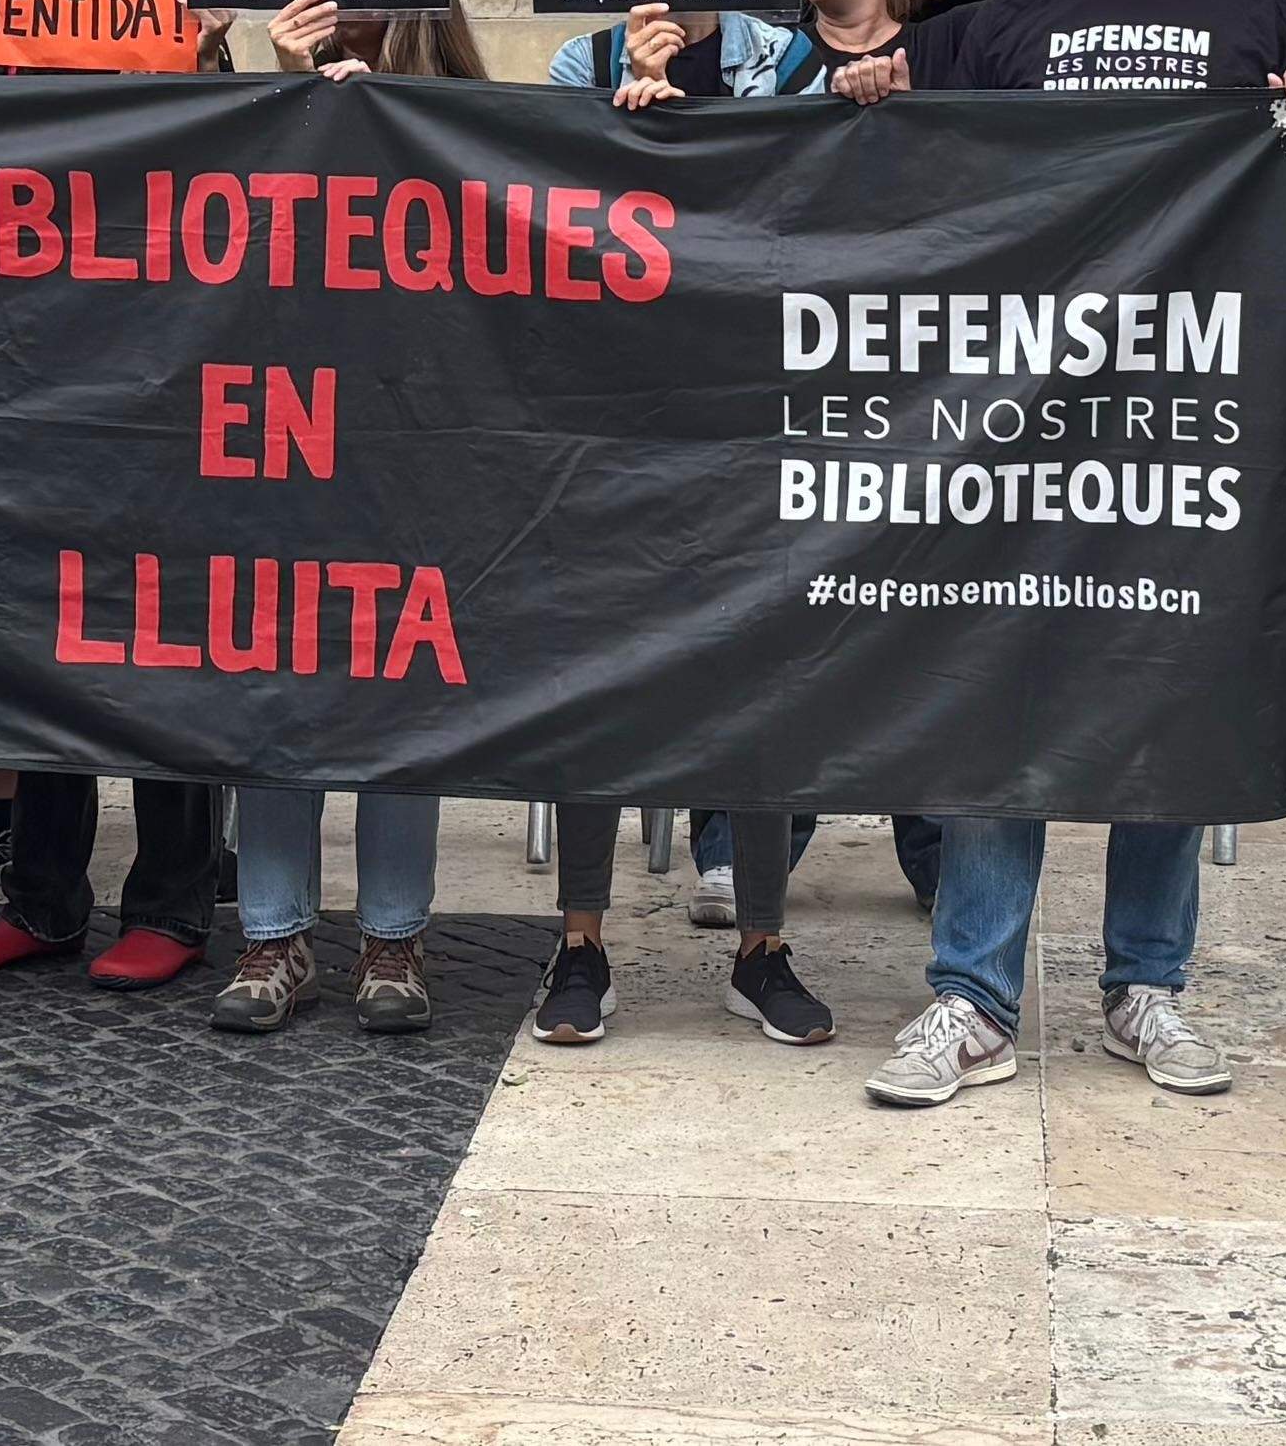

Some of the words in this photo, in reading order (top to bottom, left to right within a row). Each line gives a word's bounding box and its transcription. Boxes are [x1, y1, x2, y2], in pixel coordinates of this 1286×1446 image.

[1046, 58, 1083, 75] LES
[1096, 56, 1208, 76] NOSTRES
[1049, 24, 1210, 58] DEFENSEM
[782, 291, 1242, 377] DEFENSEM
[199, 363, 336, 479] EN
[783, 395, 891, 440] LES
[932, 396, 1240, 445] NOSTRES
[779, 458, 1242, 531] BIBLIOTEQUES
[55, 549, 467, 685] LLUITA
[806, 574, 1200, 615] #defensemBibliosBcn
